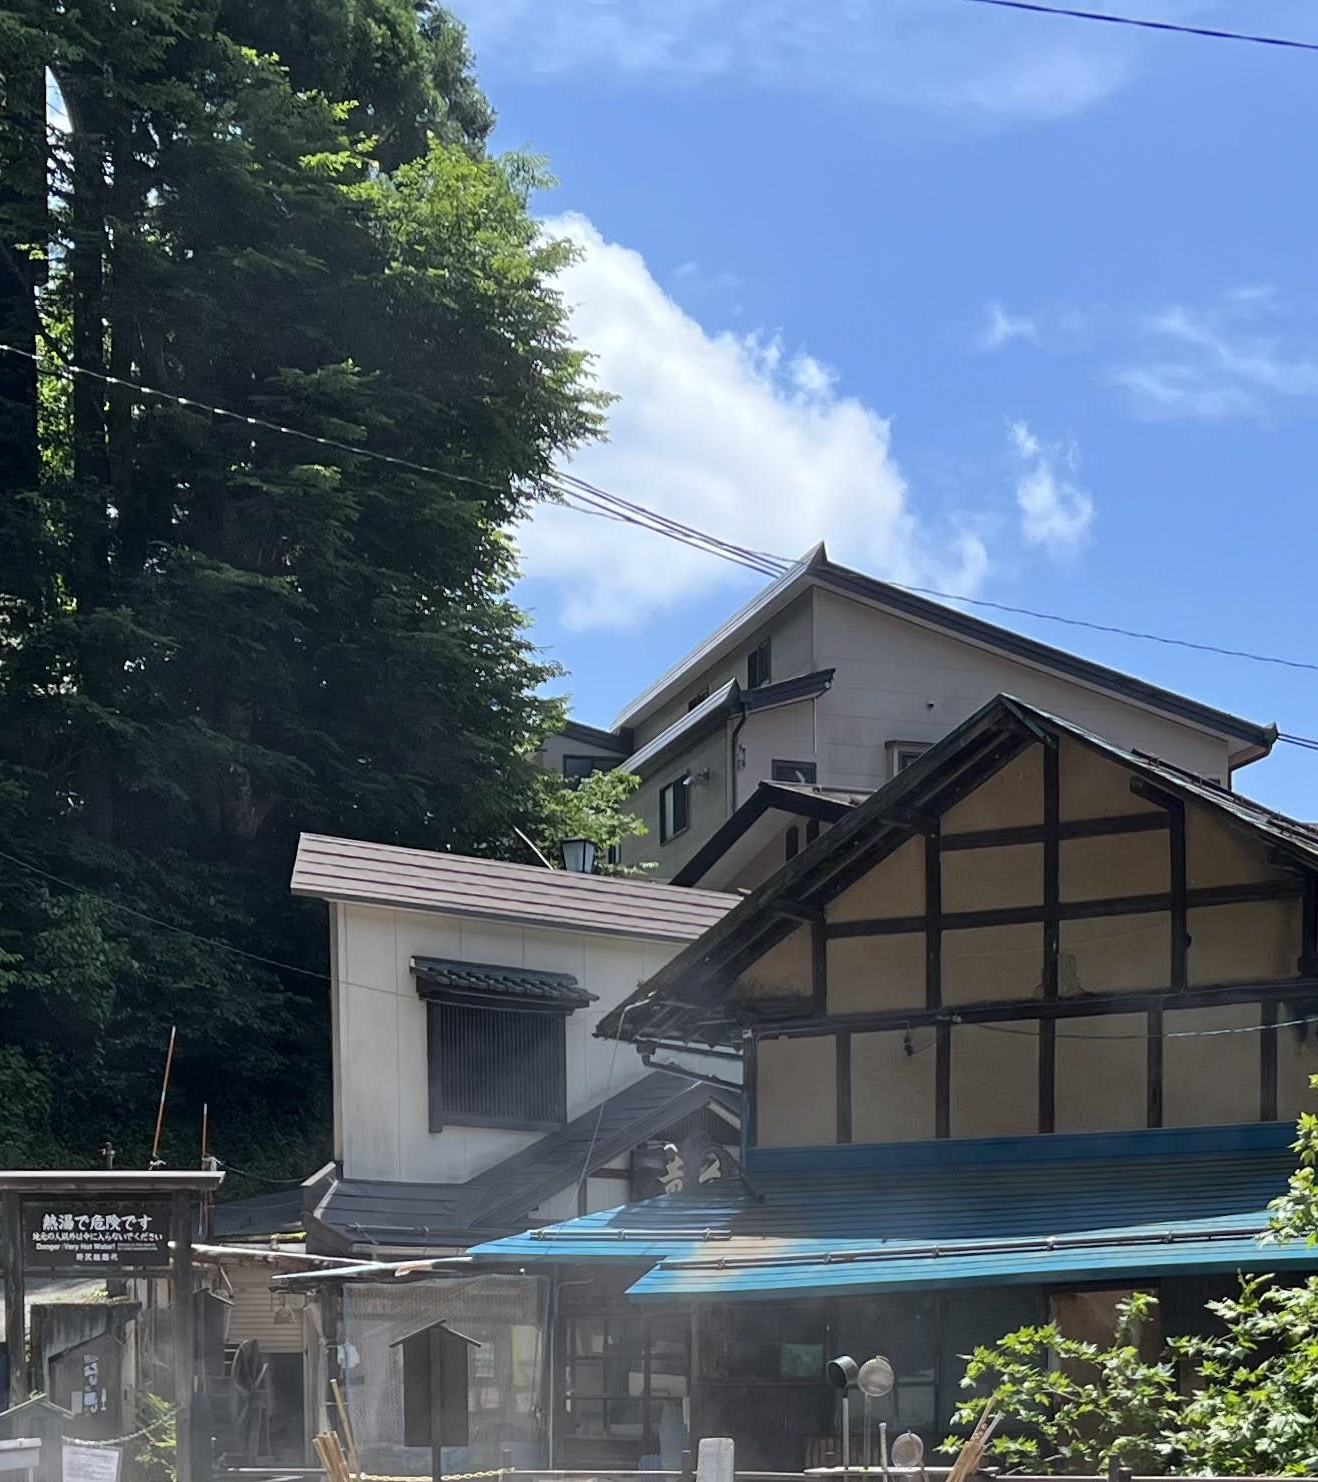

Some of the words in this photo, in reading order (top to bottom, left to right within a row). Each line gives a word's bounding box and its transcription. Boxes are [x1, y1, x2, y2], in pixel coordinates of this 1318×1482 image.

[42, 1214, 152, 1231] 熱湯で危険です
[32, 1231, 163, 1242] 地元の人以外は中に入らないでください
[36, 1243, 60, 1251] Danger
